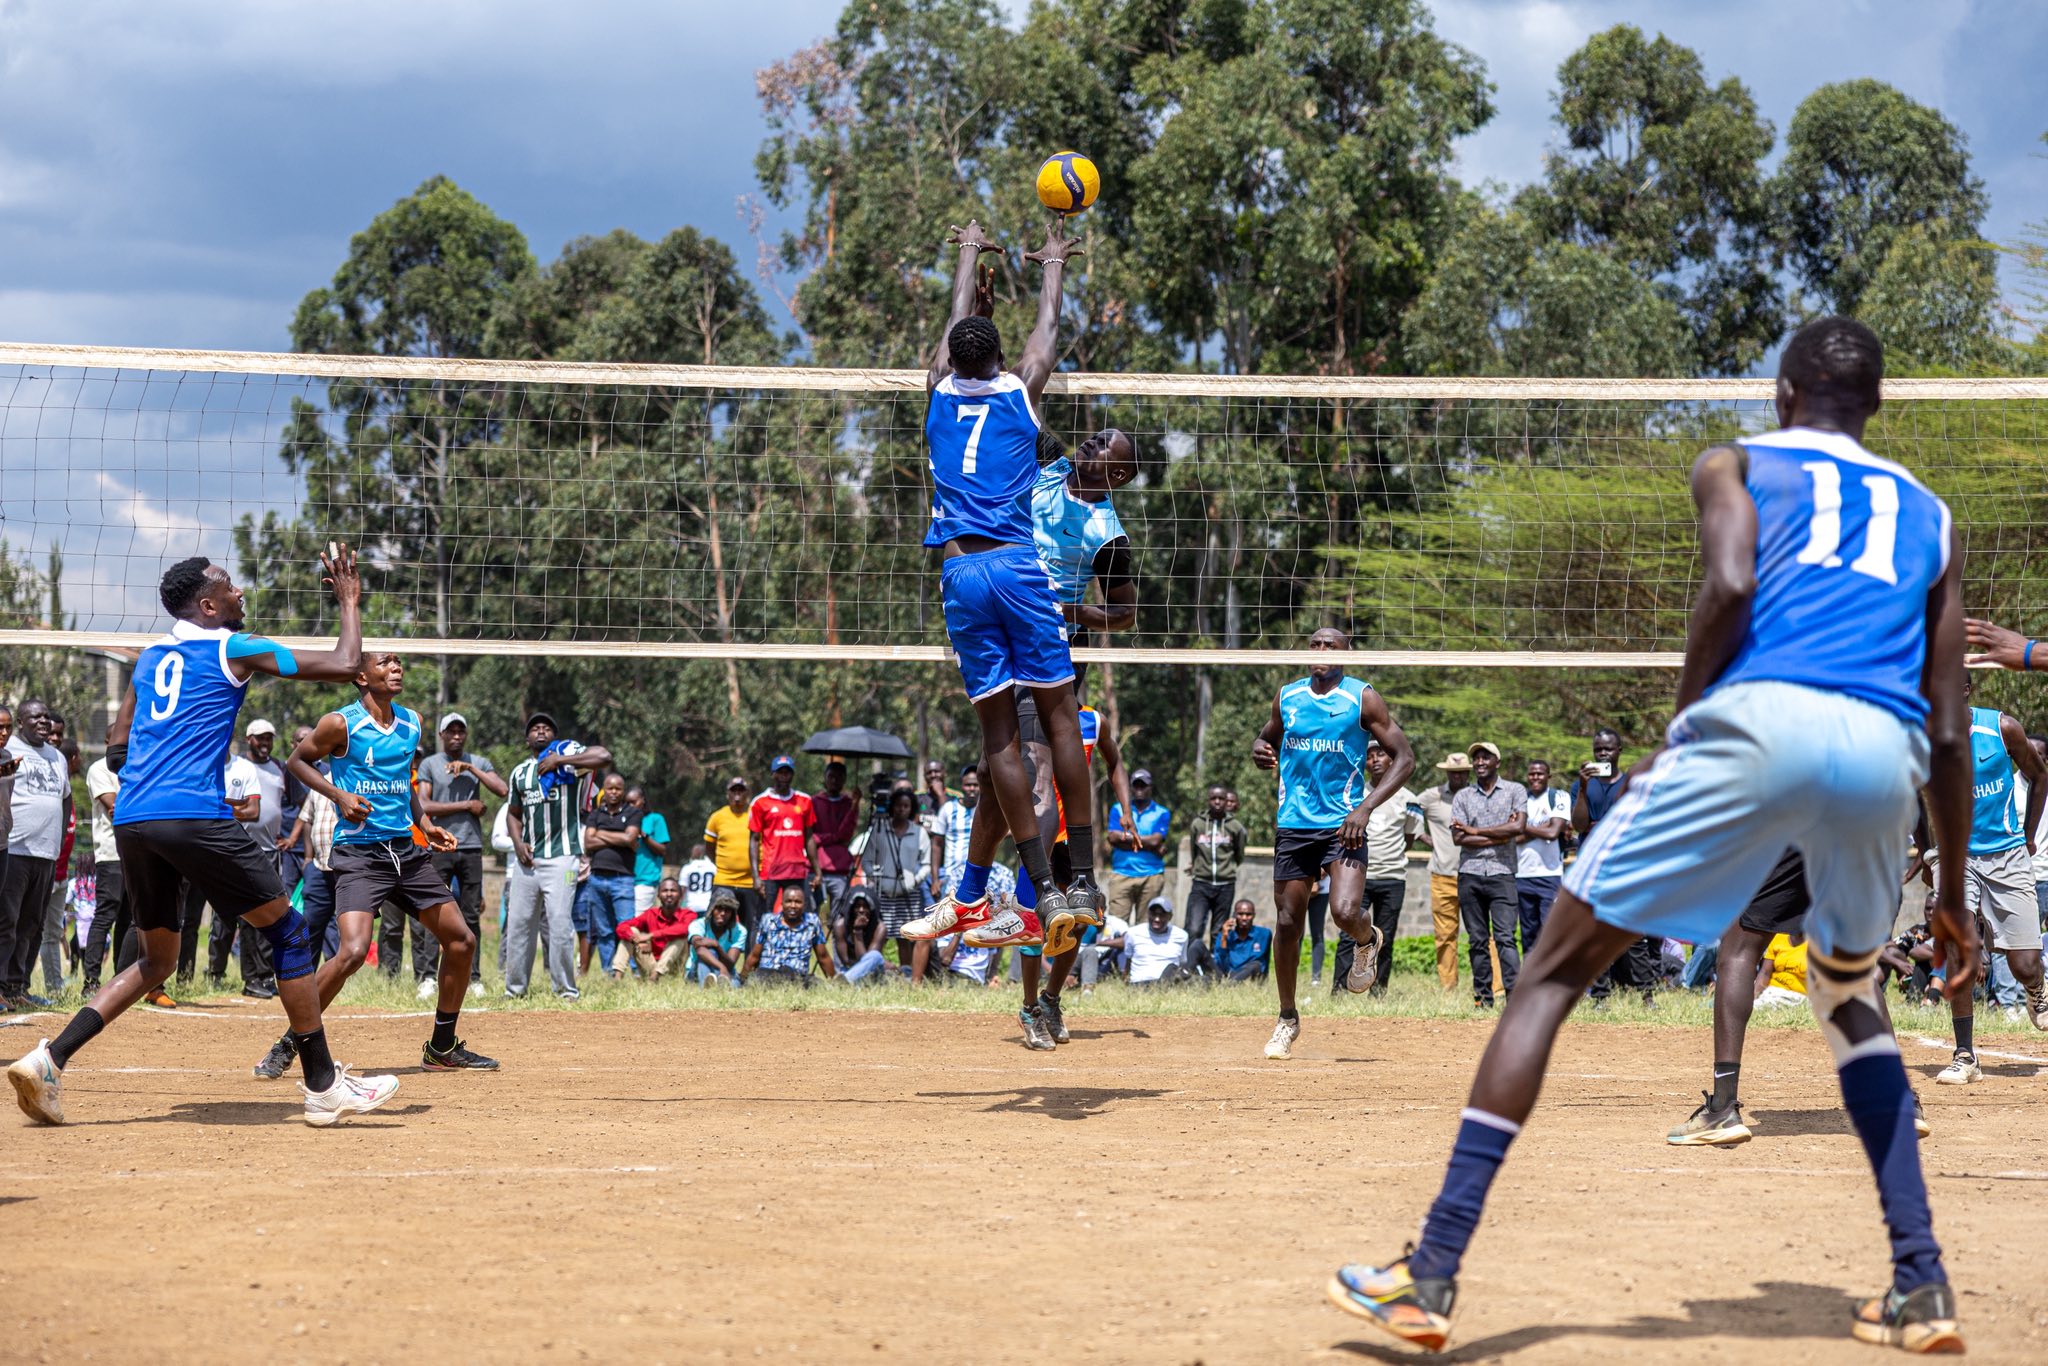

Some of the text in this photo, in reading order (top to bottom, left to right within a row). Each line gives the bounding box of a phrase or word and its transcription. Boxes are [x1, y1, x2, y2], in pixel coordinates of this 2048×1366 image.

[957, 404, 990, 474] 7
[1796, 461, 1900, 587] 11
[150, 651, 184, 721] 9
[1288, 708, 1298, 728] 3
[364, 746, 374, 768] 4
[1285, 739, 1345, 753] ABASS KHALIF
[353, 780, 389, 795] ABASS
